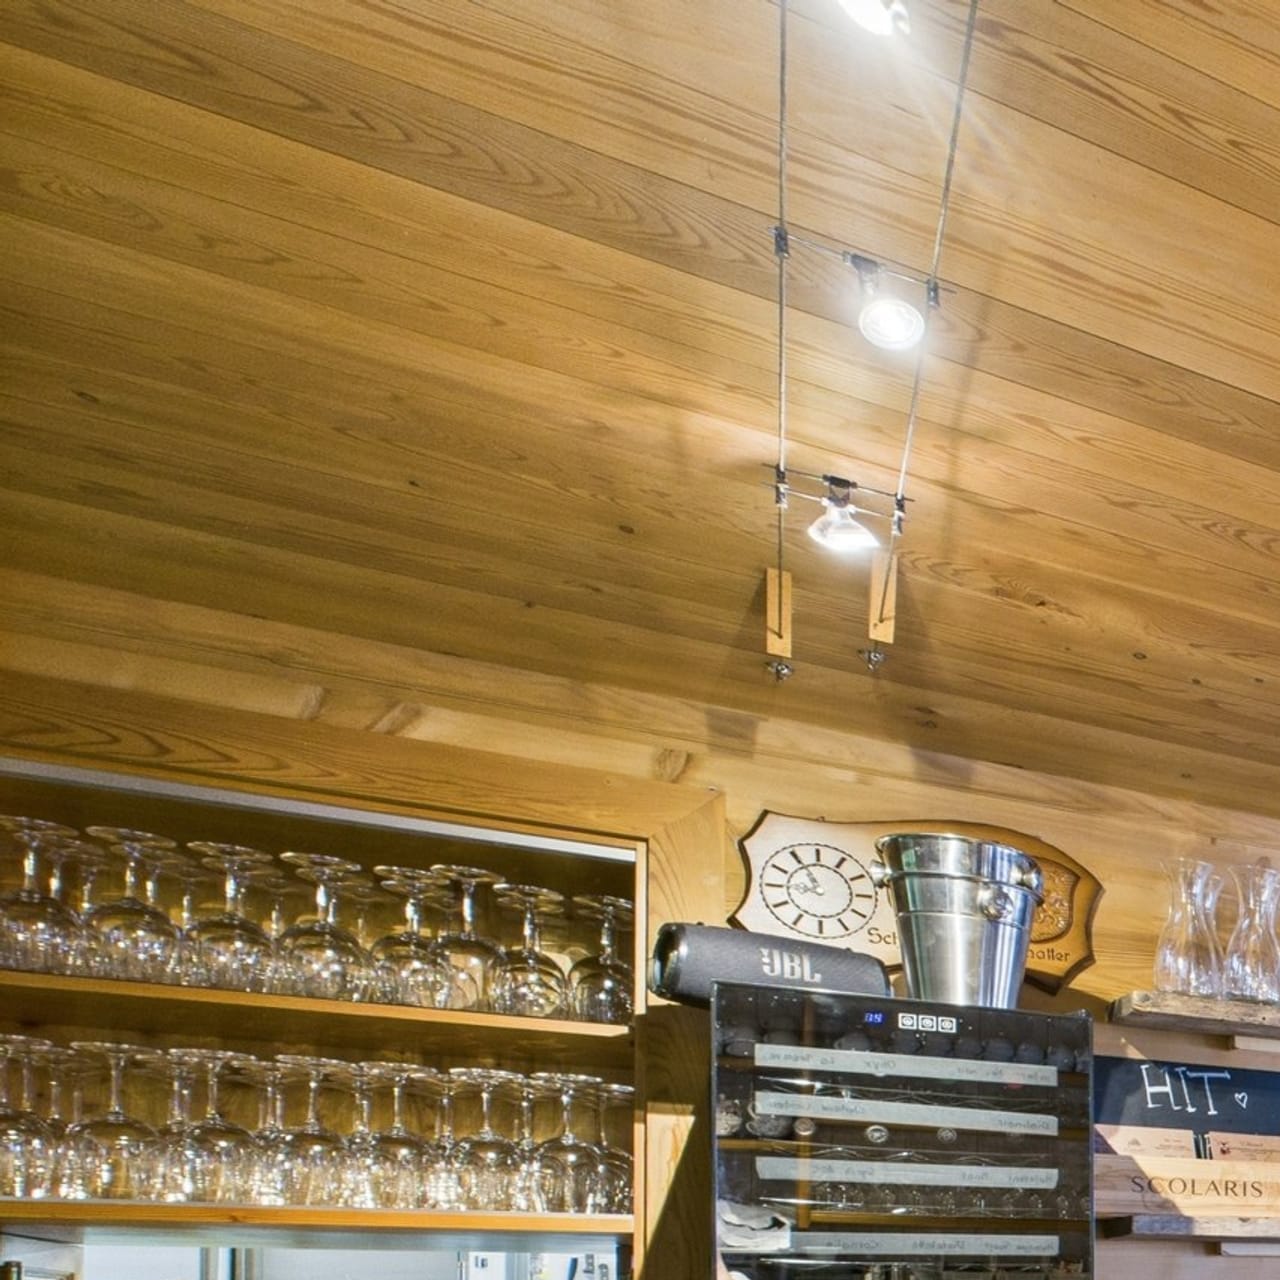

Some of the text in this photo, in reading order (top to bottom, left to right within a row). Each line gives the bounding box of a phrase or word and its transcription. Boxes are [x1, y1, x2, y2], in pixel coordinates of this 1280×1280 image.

[760, 948, 822, 983] JBL
[1140, 1064, 1231, 1116] HIT
[1131, 1175, 1264, 1199] SCOLARIS
